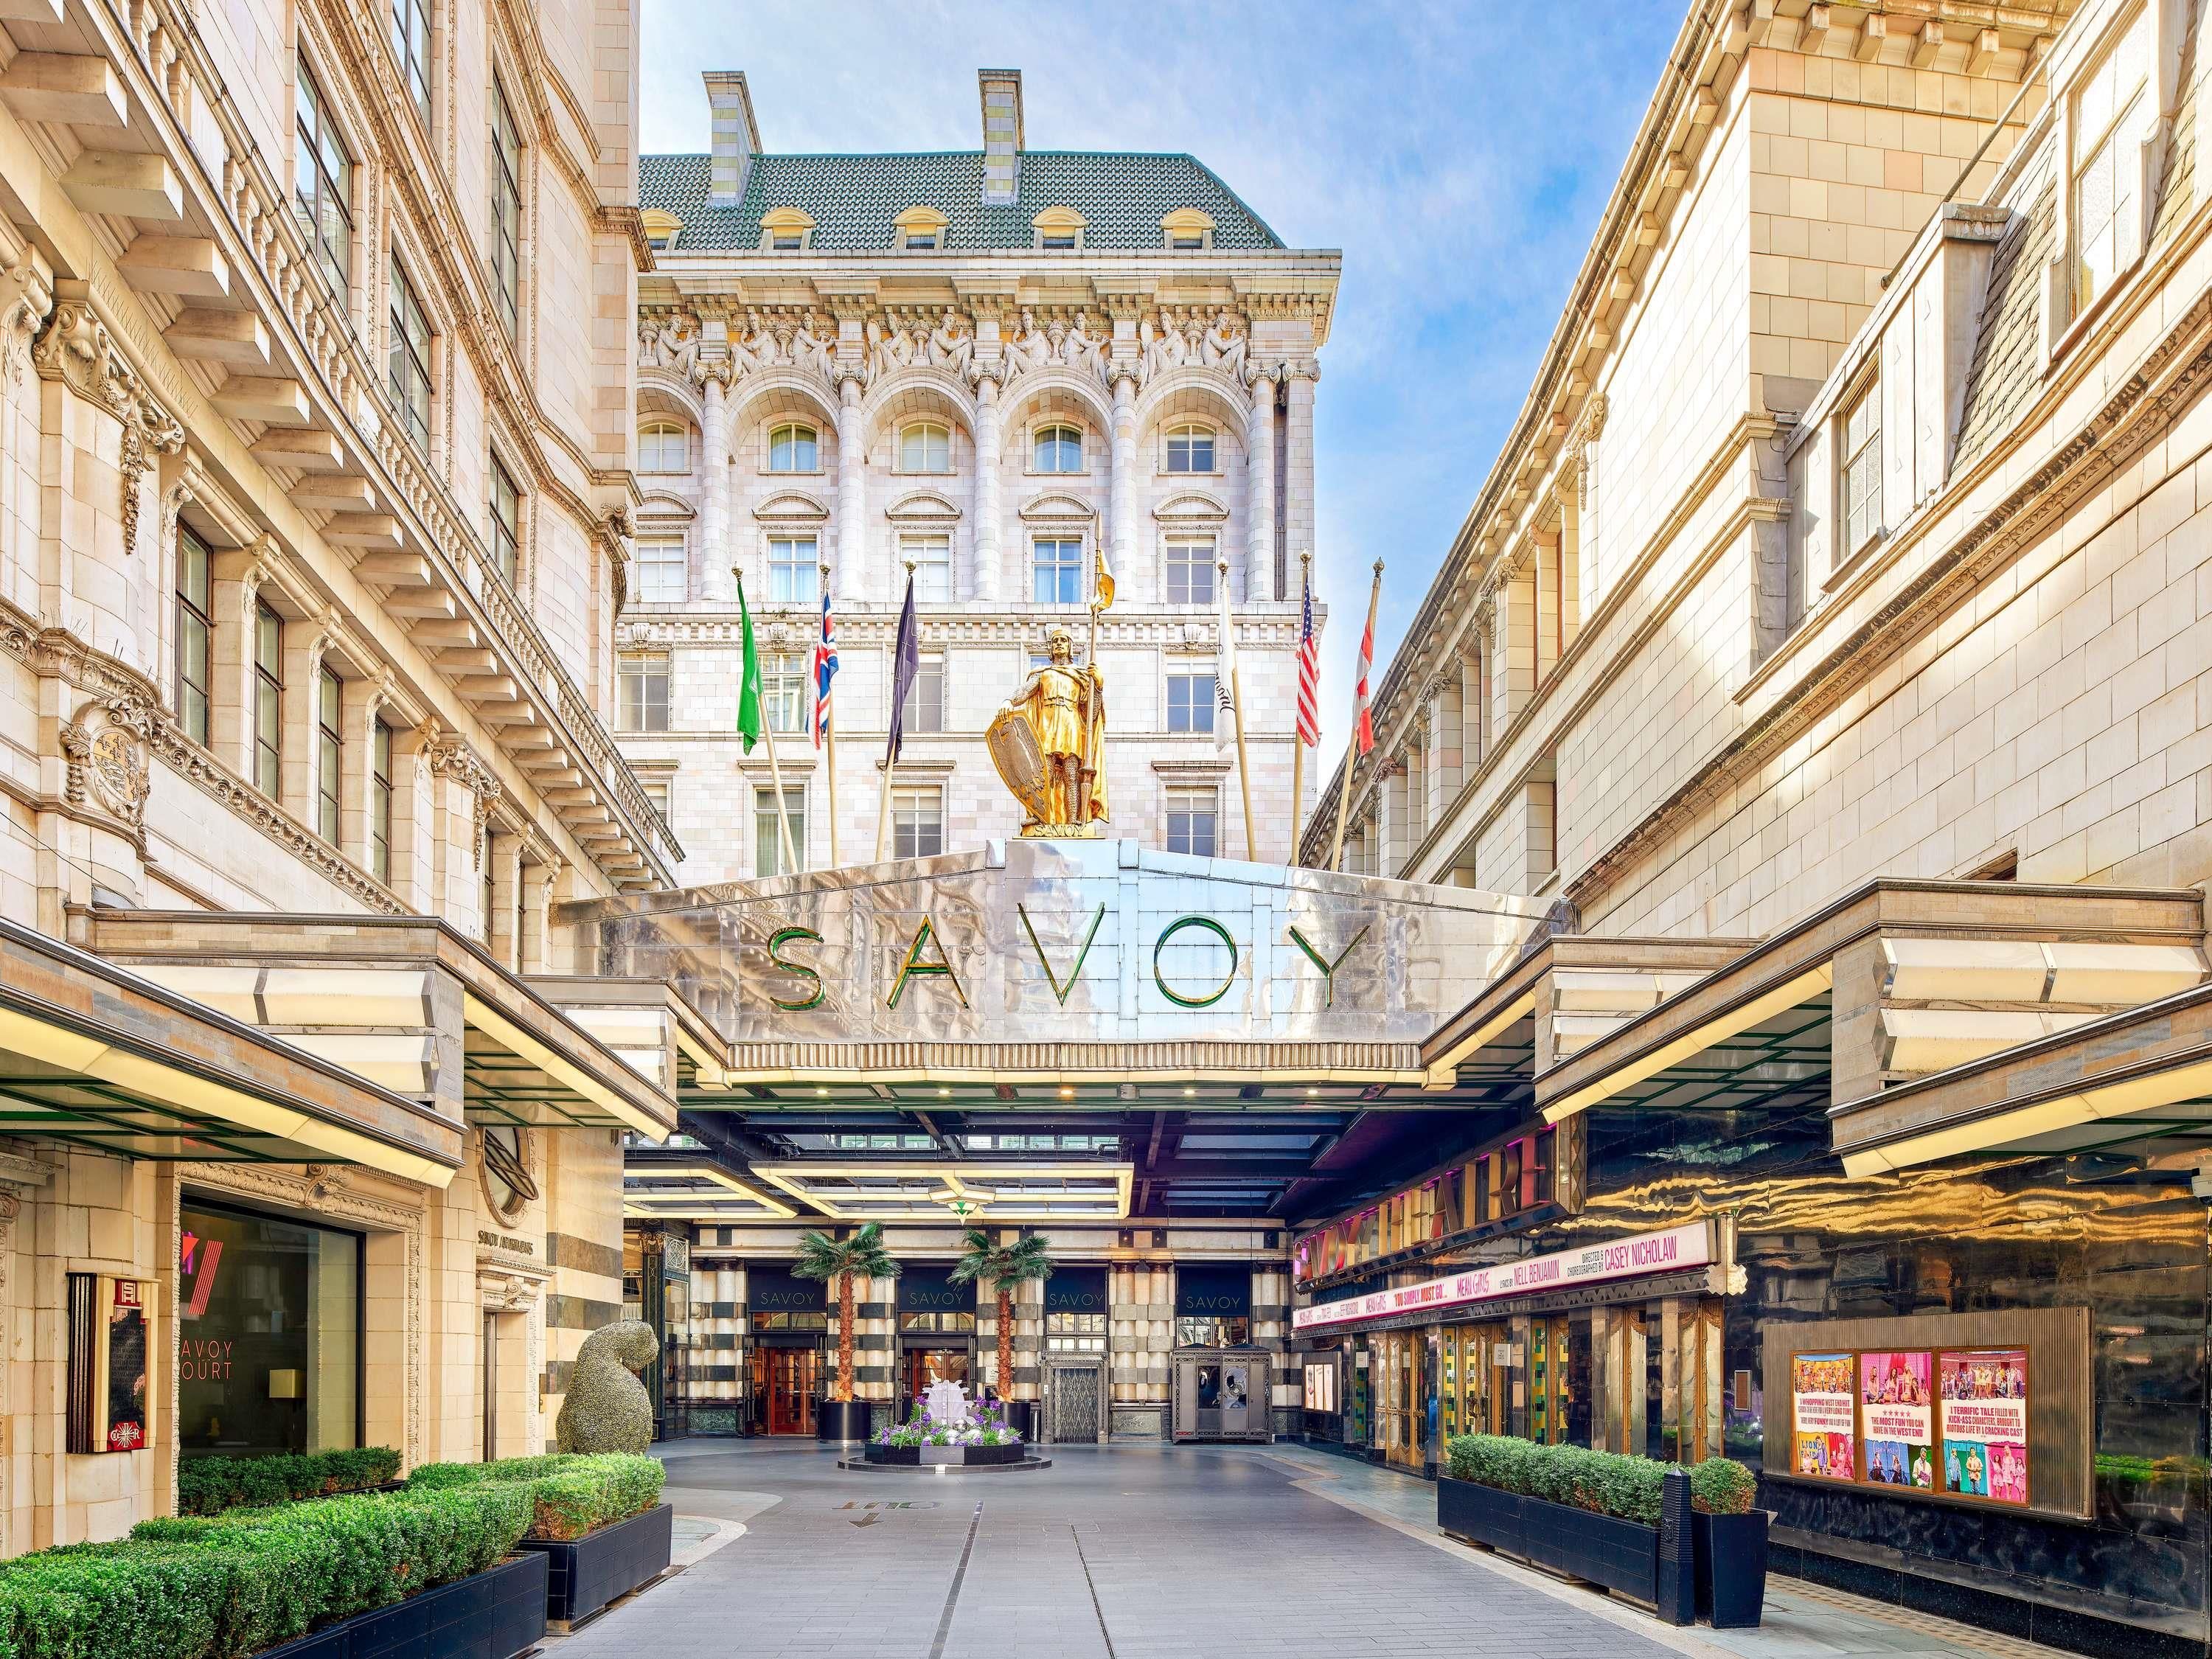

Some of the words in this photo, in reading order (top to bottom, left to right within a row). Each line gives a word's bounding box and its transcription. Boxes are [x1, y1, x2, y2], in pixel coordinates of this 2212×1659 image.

[1034, 824, 1087, 837] SAVOY
[767, 901, 1370, 1012] SAVOY
[1582, 1251, 1600, 1264] DIRECTED
[1604, 1245, 1630, 1270] CASEY
[1632, 1235, 1677, 1267] NICHOLAW
[1514, 1267, 1528, 1287] NELL
[1528, 1259, 1559, 1284] BENJAMIN
[1567, 1263, 1598, 1277] CHOREOGRAPHED
[1598, 1263, 1604, 1272] BY
[1457, 1276, 1472, 1298] MEAN
[1472, 1271, 1489, 1295] GIRLS
[760, 1293, 815, 1305] SAVOY
[909, 1292, 964, 1305] SAVOY
[1048, 1293, 1104, 1306] SAVOY
[1186, 1296, 1240, 1309] SAVOY
[181, 1340, 232, 1358] AVOY
[181, 1361, 232, 1380] OURT
[1802, 1398, 1825, 1406] WHOPPING
[1953, 1406, 1979, 1416] TERRIFIC
[1980, 1407, 1994, 1416] TALE
[1994, 1408, 2008, 1417] FILLED
[2008, 1408, 2019, 1418] WITH
[1815, 1417, 1829, 1425] FUNNY
[1879, 1417, 1895, 1426] MOST
[1895, 1418, 1906, 1427] FUN
[1906, 1419, 1915, 1427] YOU
[1915, 1419, 1924, 1427] CAN
[1948, 1415, 1972, 1425] KICK-ASS
[1997, 1417, 2014, 1427] BROUGHT
[2014, 1418, 2020, 1427] TO
[1874, 1426, 1883, 1434] HAVE
[1883, 1426, 1888, 1435] IN
[1888, 1427, 1896, 1435] THE
[1896, 1427, 1912, 1436] WEST
[1947, 1424, 1966, 1433] RIOTOUS
[1966, 1425, 1975, 1434] LIFE
[1975, 1426, 1981, 1434] BY
[1985, 1426, 2009, 1436] CRACKING
